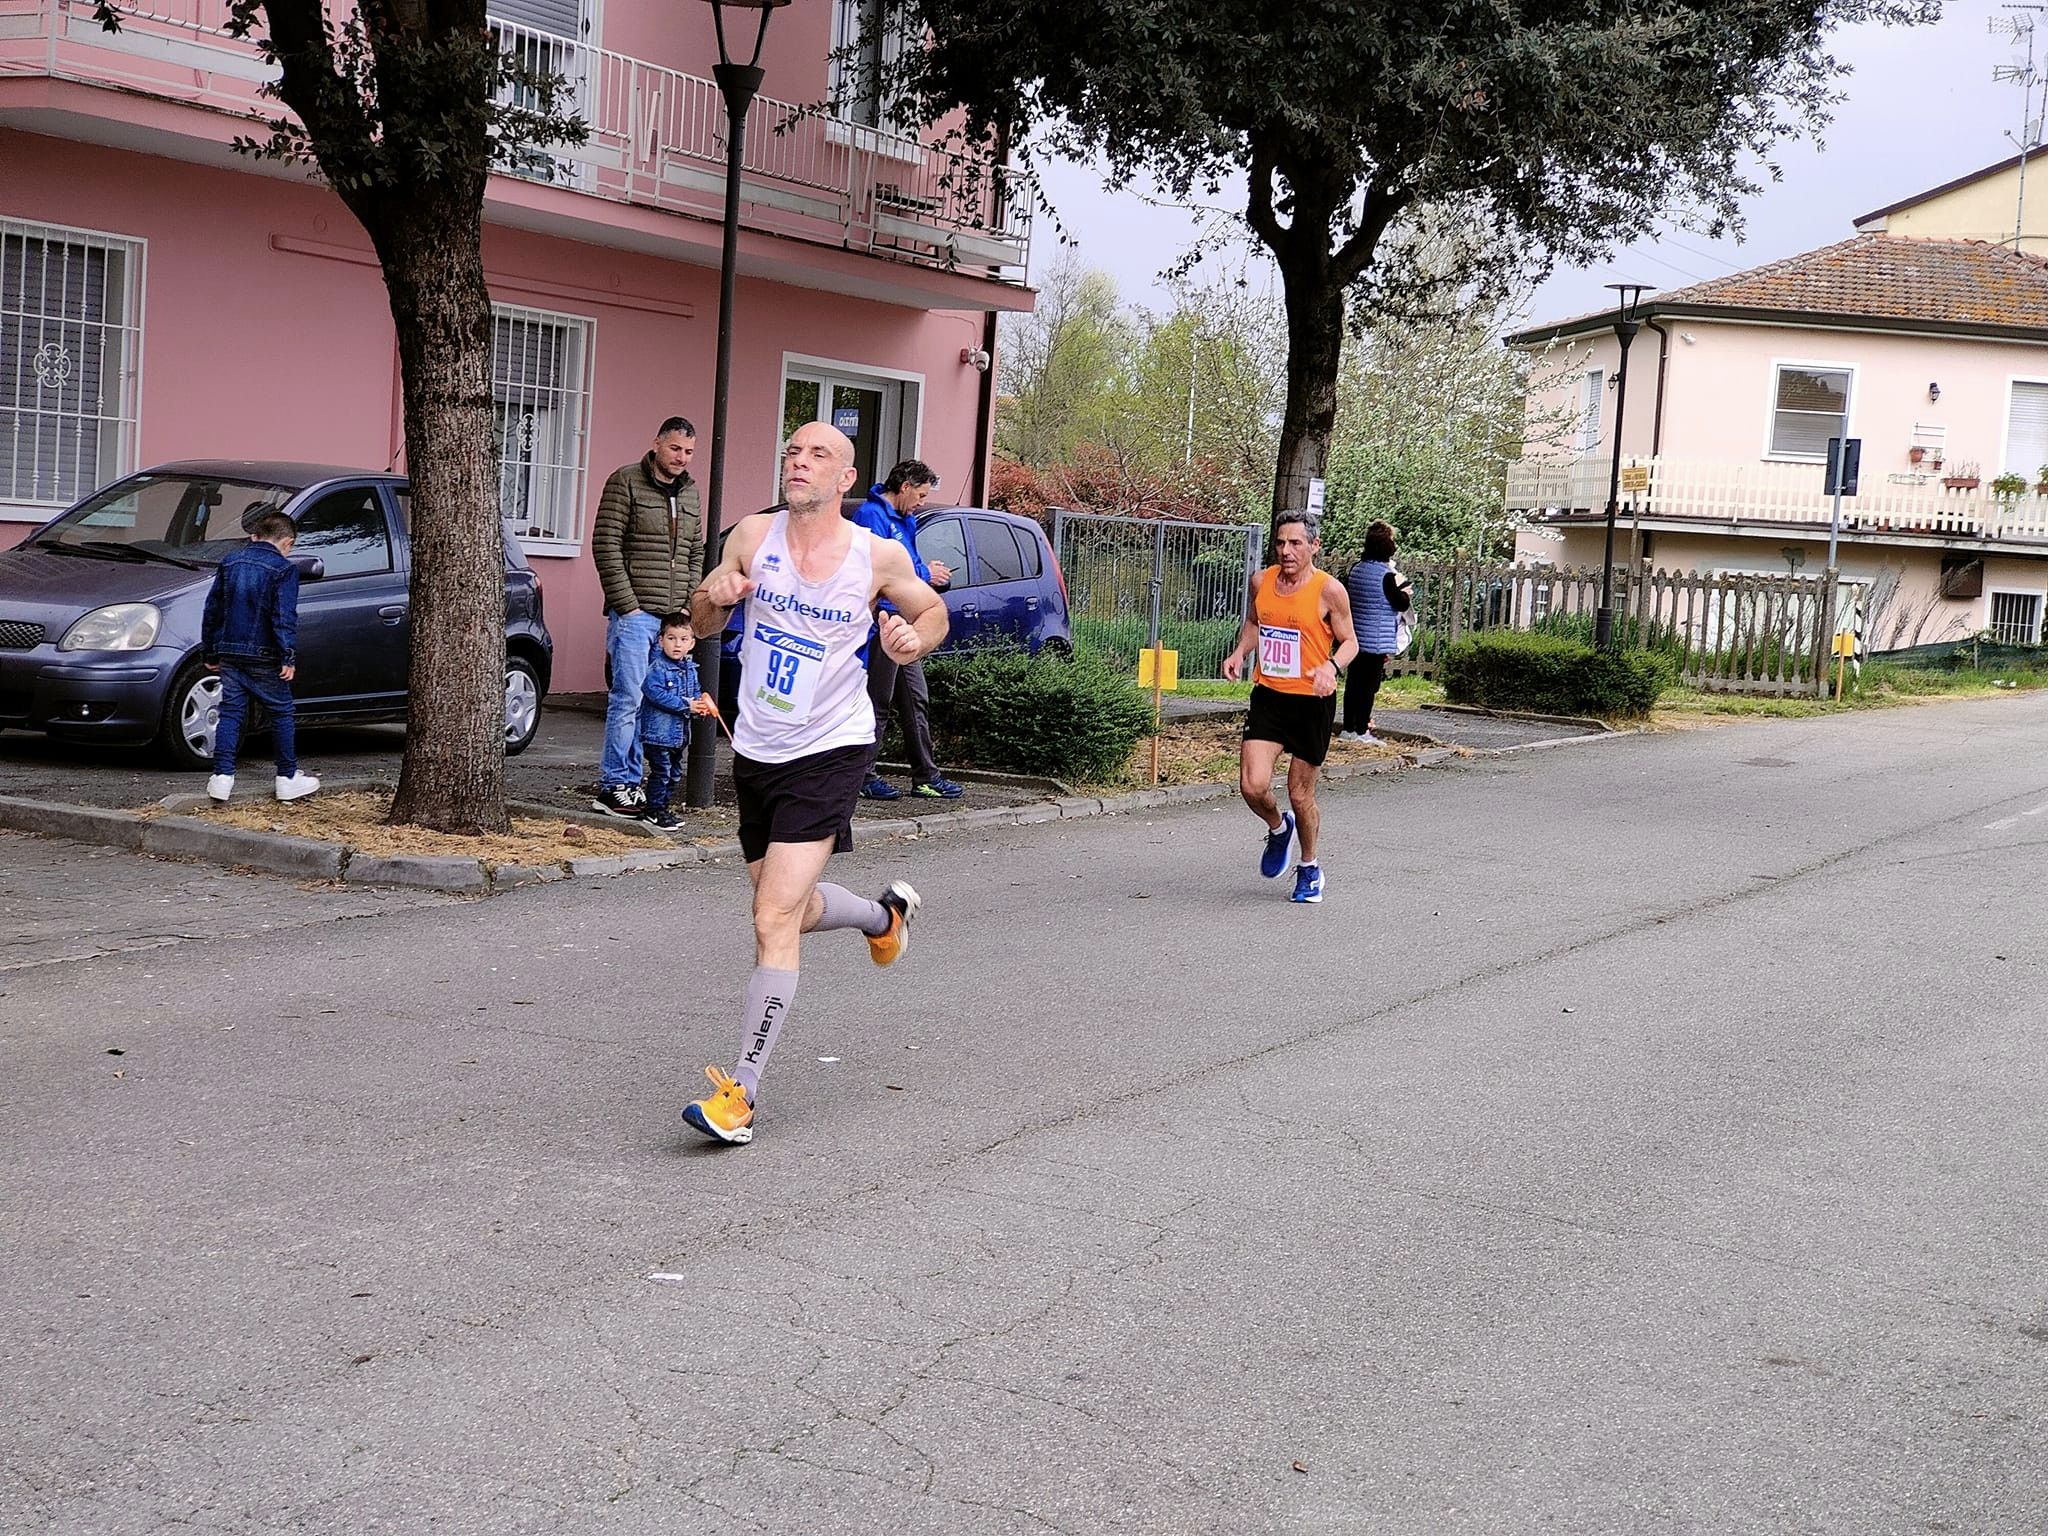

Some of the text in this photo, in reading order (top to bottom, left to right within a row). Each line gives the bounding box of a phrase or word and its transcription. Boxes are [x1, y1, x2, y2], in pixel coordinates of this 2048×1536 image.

[755, 583, 852, 623] lughesina
[1263, 639, 1292, 665] 209
[766, 649, 800, 696] 93
